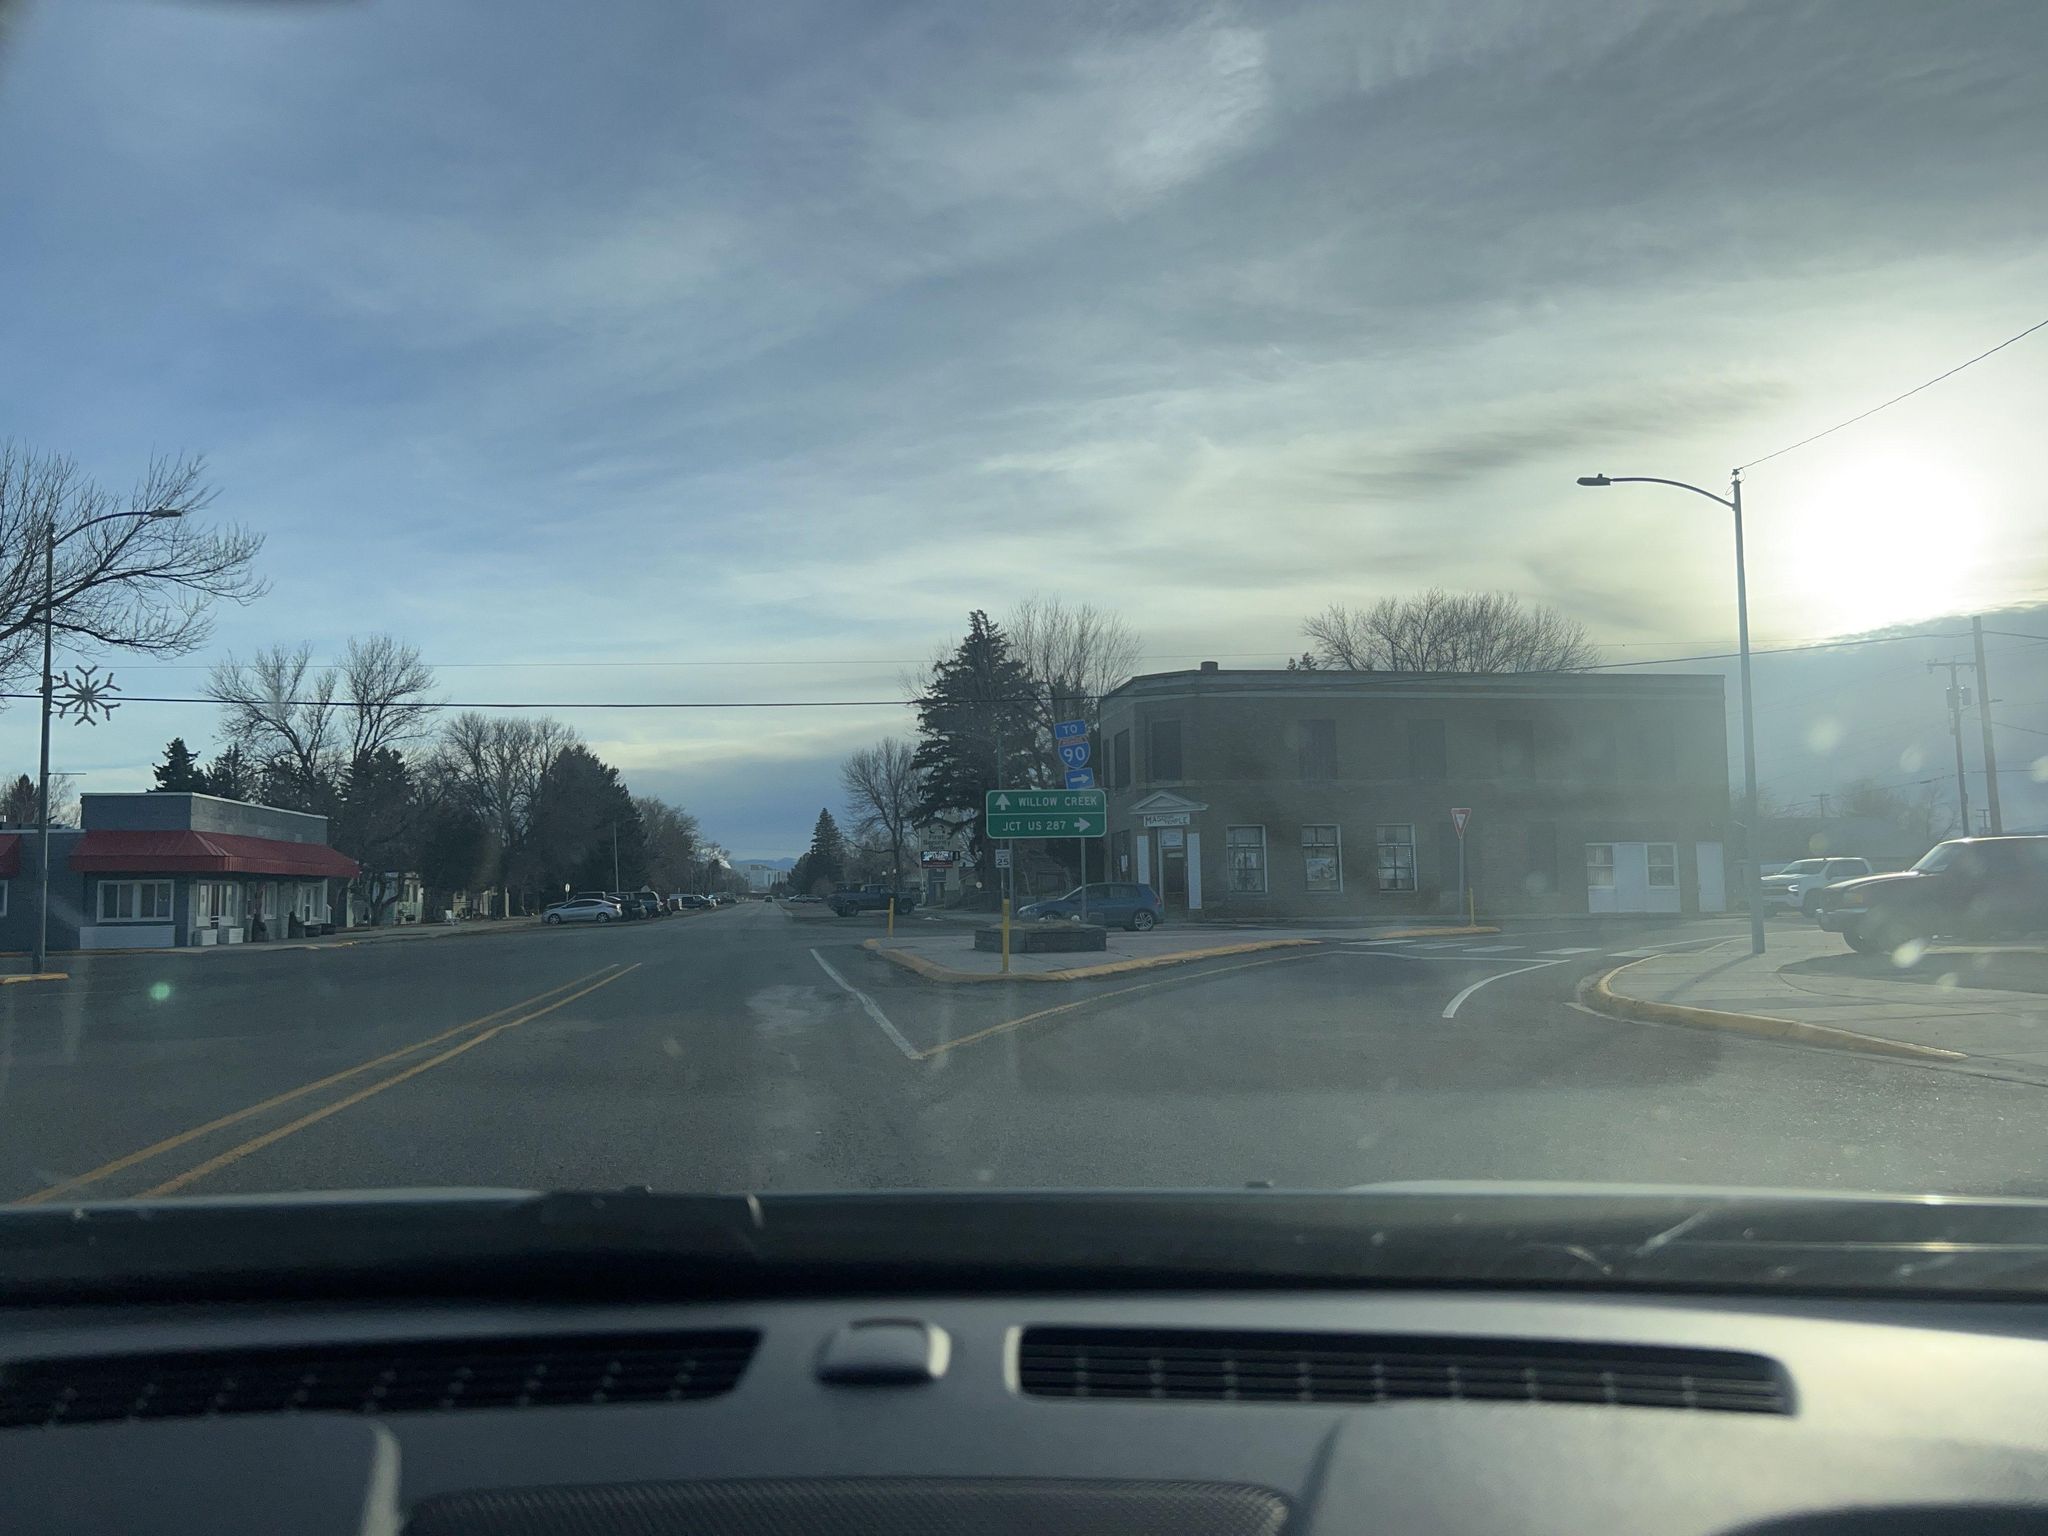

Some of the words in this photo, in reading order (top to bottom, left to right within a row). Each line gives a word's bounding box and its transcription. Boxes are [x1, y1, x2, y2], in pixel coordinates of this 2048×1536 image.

[1062, 724, 1077, 734] TO
[1064, 746, 1085, 762] 90
[1018, 797, 1057, 807] WILLOW
[1064, 796, 1097, 806] CREEK
[1002, 822, 1021, 832] JCT
[1028, 821, 1042, 830] US
[1046, 821, 1066, 830] 287
